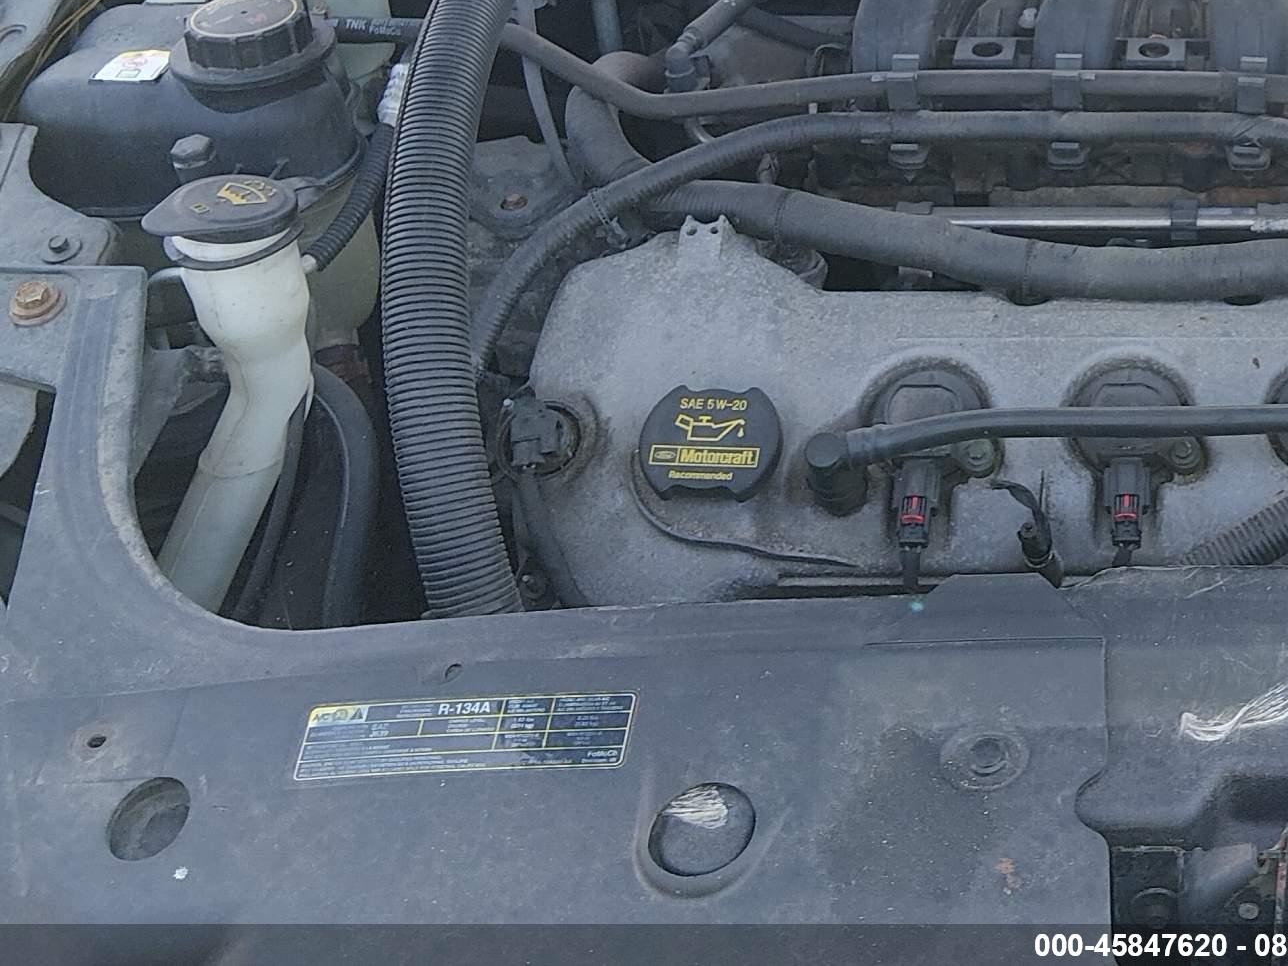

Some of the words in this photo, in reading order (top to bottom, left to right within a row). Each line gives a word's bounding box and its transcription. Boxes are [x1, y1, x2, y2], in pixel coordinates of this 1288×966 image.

[680, 398, 704, 409] SAE
[707, 399, 747, 411] 5W-20
[680, 449, 754, 465] Motorcraft
[669, 471, 733, 481] Recommended
[438, 702, 491, 715] R-134A
